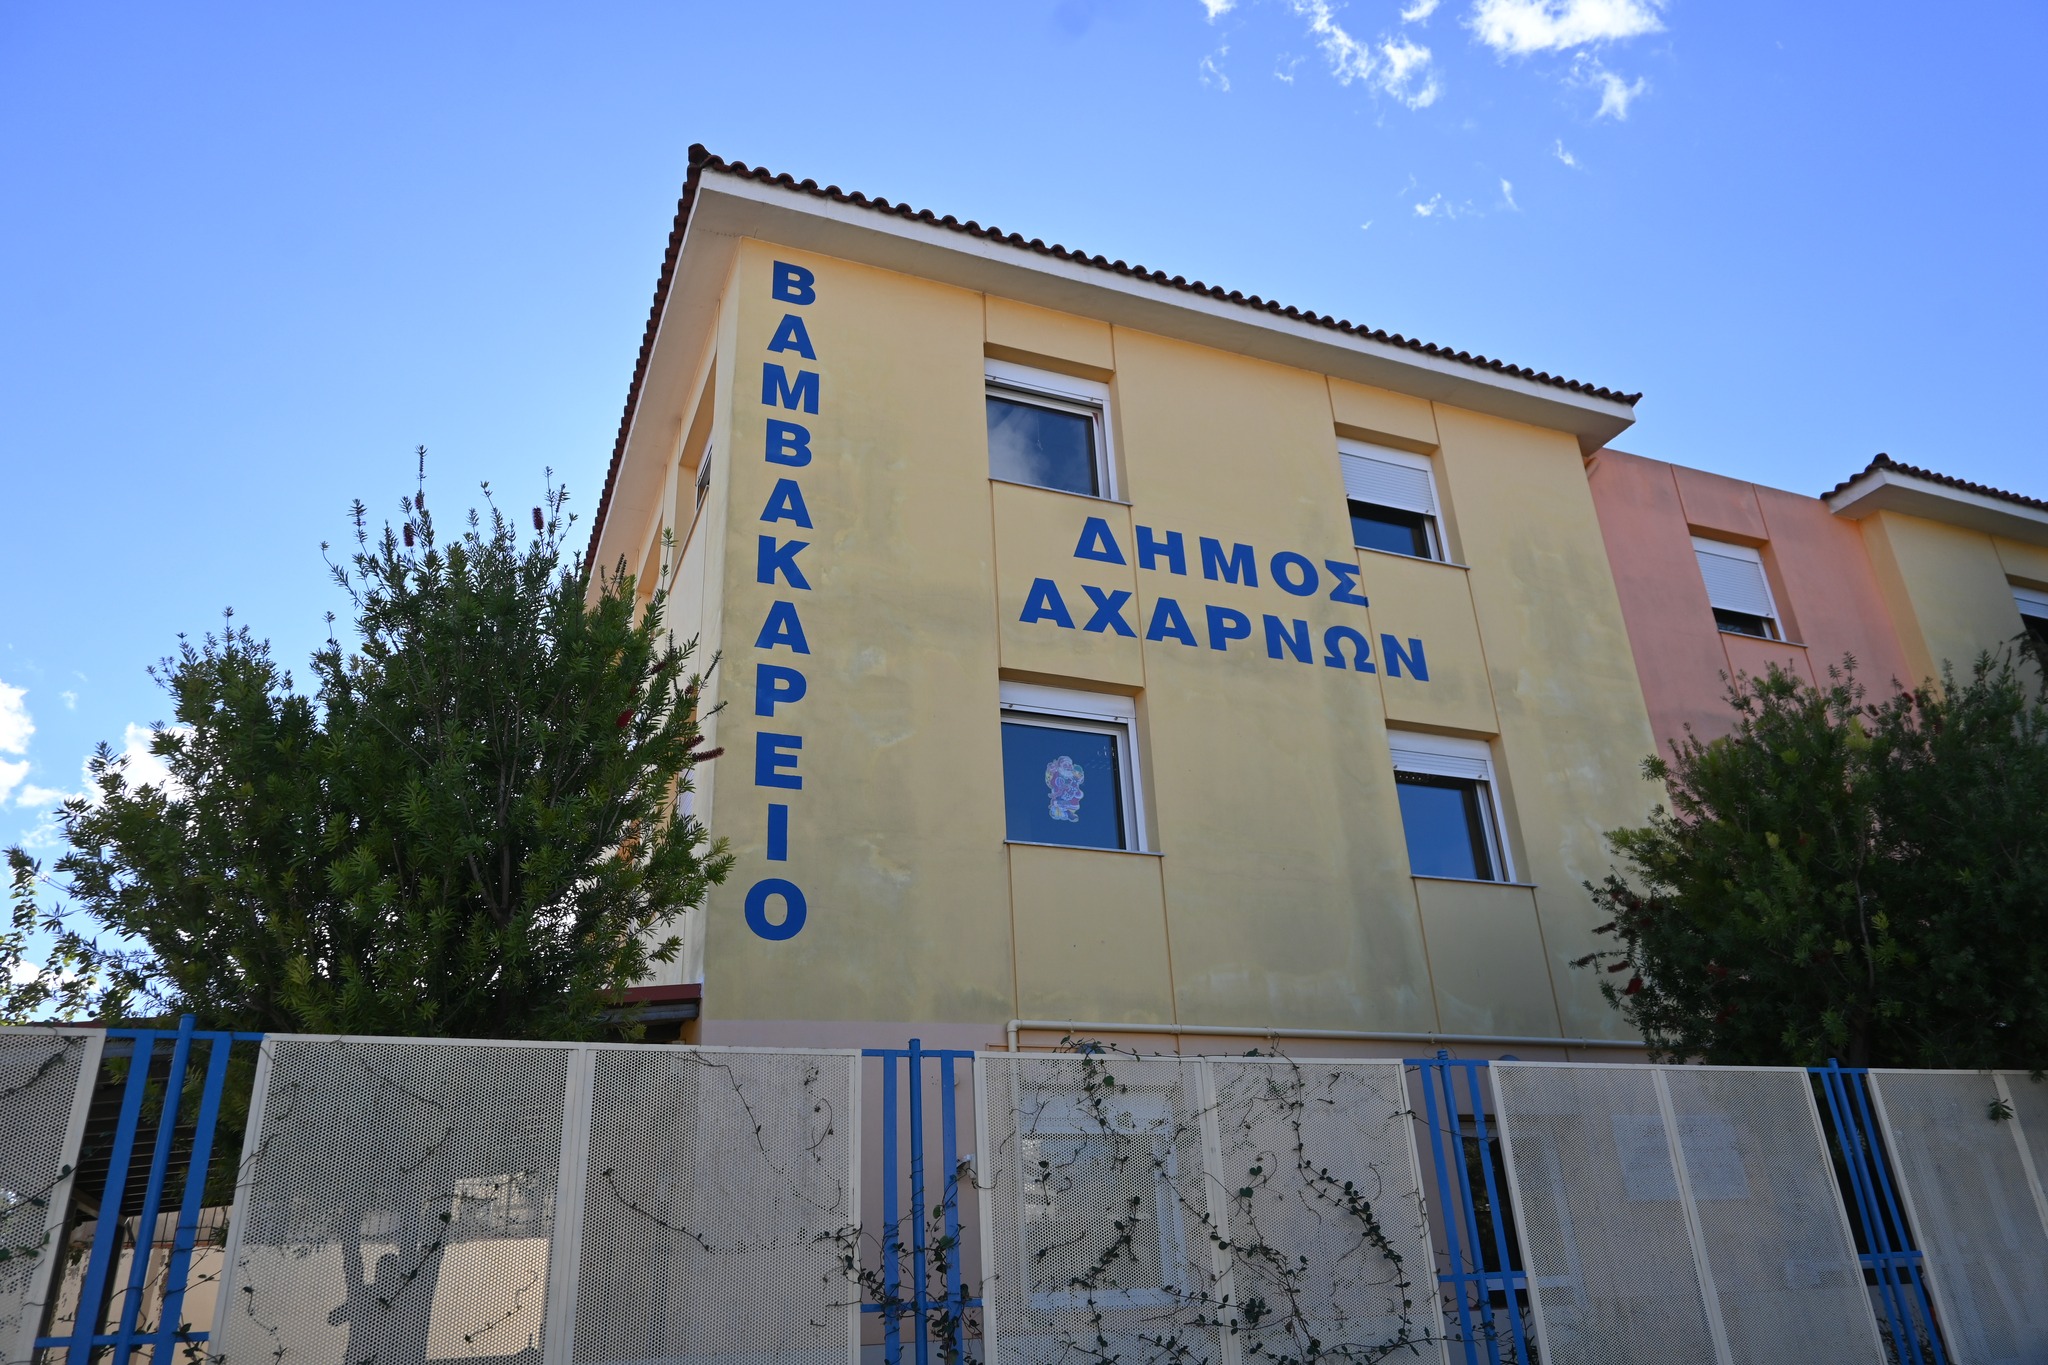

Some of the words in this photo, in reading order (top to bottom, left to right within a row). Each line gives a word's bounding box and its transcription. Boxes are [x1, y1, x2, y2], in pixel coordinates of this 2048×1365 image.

[744, 261, 820, 941] ΒΑΜΒΑΚΑΡΕΙΟ
[1073, 517, 1369, 607] ΔΗΜΟΣ
[1019, 577, 1429, 682] ΑΧΑΡΝΩΝ
